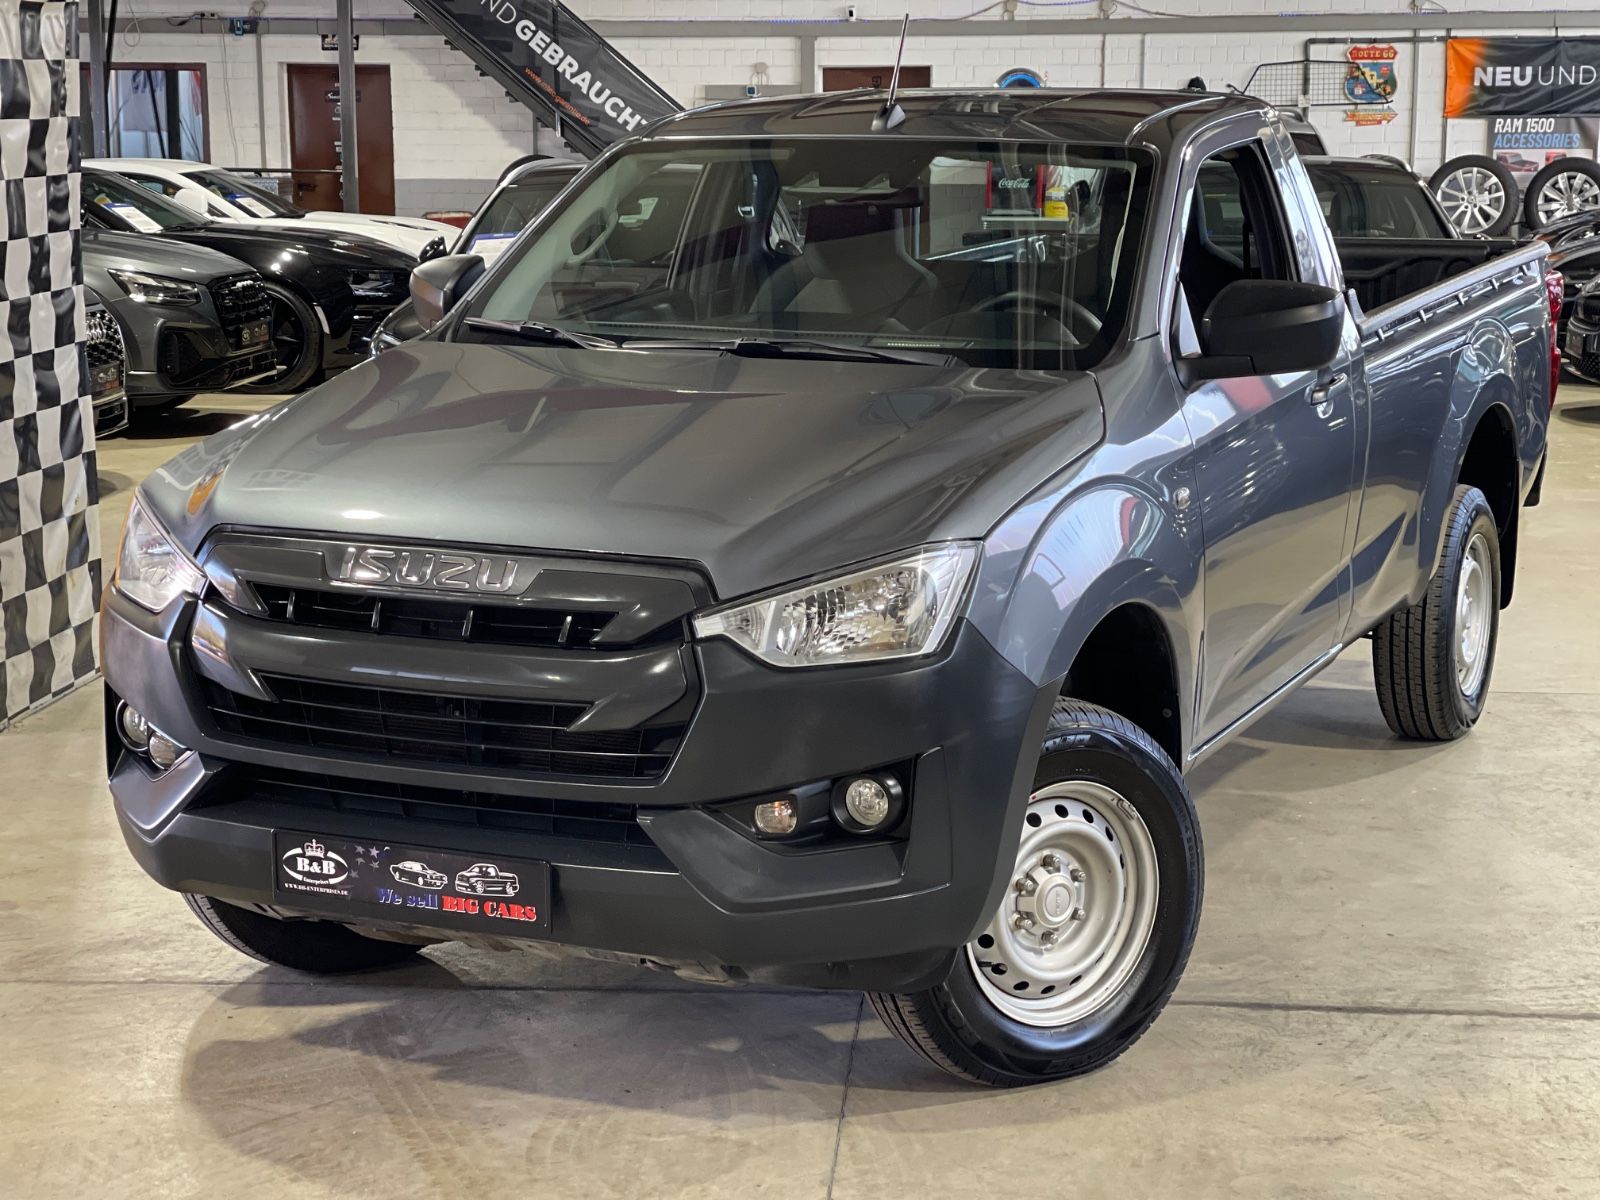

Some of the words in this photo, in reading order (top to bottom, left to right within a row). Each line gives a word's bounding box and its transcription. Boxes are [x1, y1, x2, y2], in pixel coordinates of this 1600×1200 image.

[1351, 49, 1381, 58] ROUTE
[1382, 49, 1394, 58] 66
[515, 19, 648, 132] GEBRAUCH
[1473, 66, 1533, 87] NEU
[1538, 65, 1597, 86] UND
[1494, 118, 1523, 133] RAM
[1526, 118, 1555, 133] 1500
[1493, 133, 1581, 149] ACCESSORIES
[339, 547, 518, 592] ISUZU
[296, 856, 336, 875] B&B
[376, 887, 403, 905] We
[406, 894, 438, 910] sell
[442, 895, 480, 915] BIG
[483, 900, 537, 922] CARS
